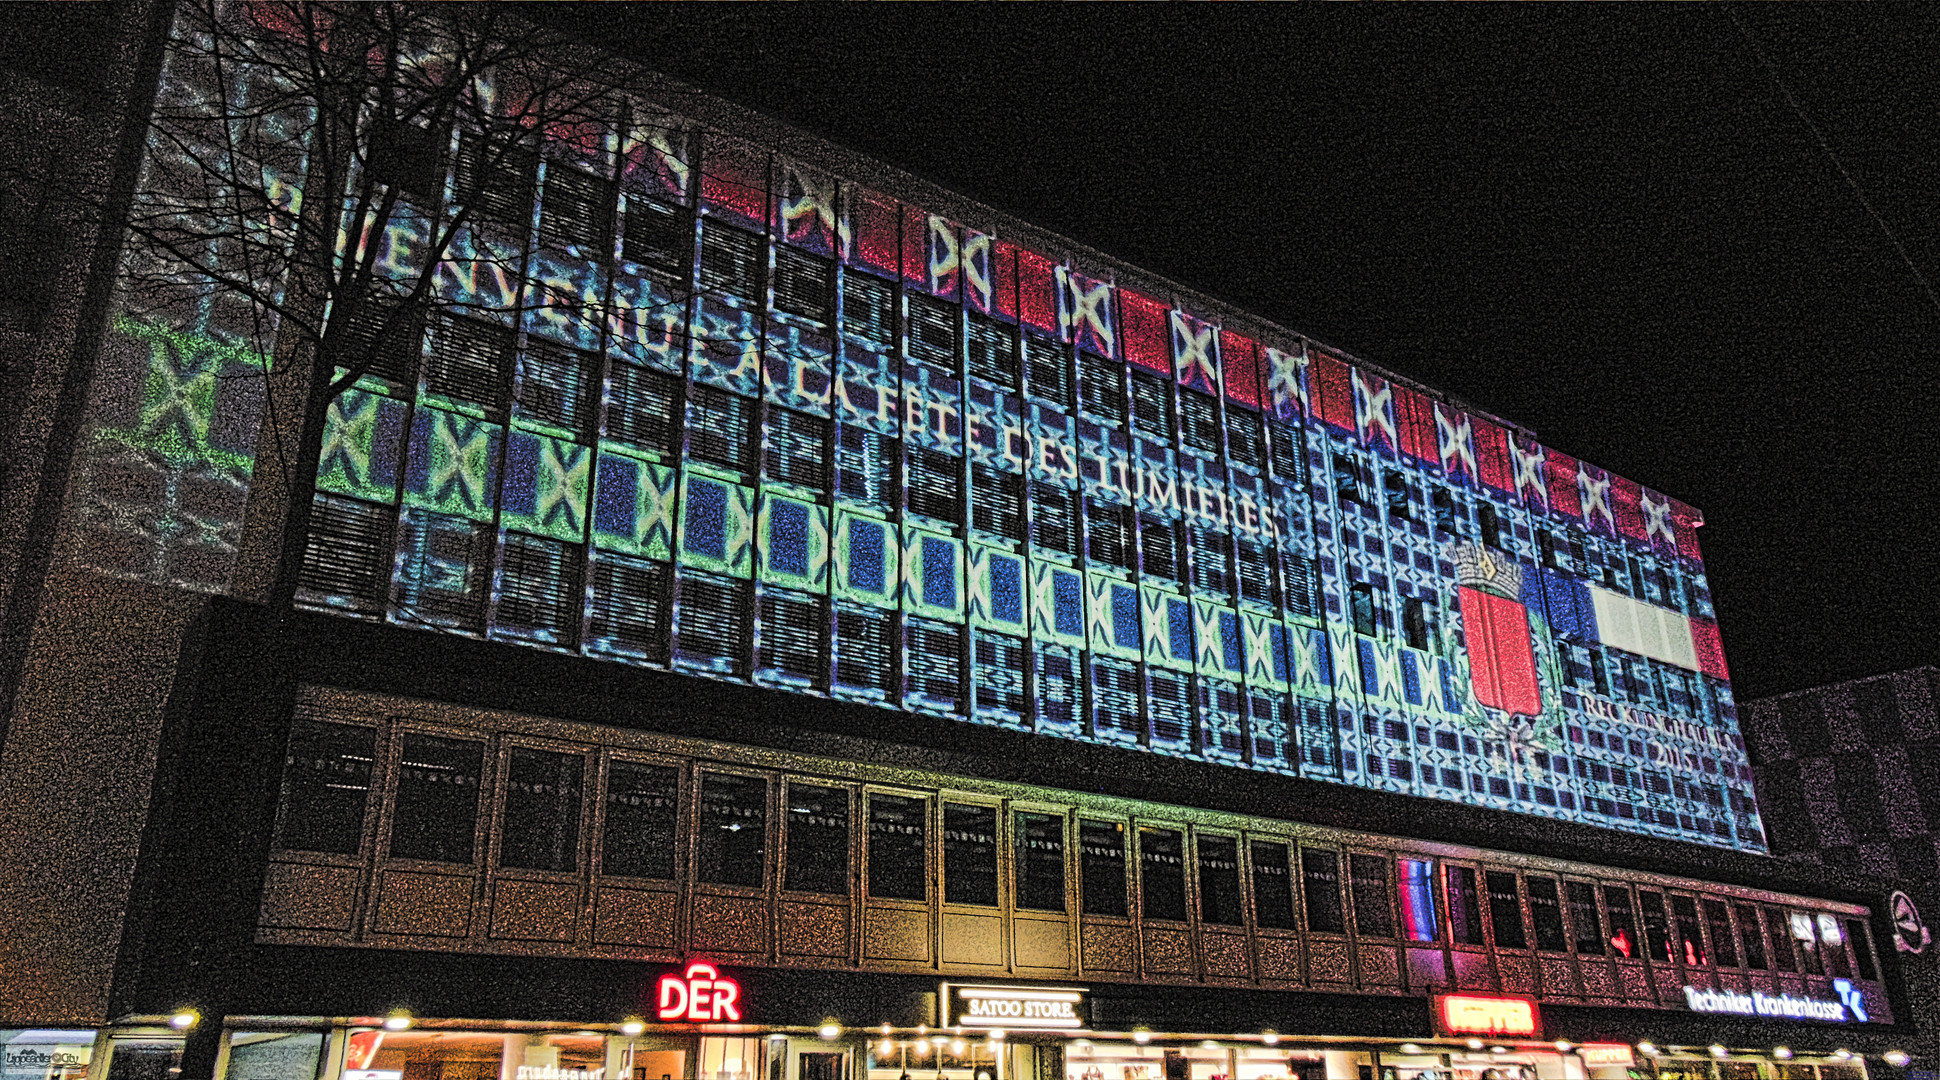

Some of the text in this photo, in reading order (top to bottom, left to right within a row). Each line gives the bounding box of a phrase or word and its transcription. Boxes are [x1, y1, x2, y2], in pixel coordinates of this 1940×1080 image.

[794, 358, 859, 415] LA
[876, 382, 983, 451] FÊTE
[1002, 420, 1080, 480] DES
[1098, 454, 1280, 540] LUMIÈRES
[659, 977, 740, 1021] DER
[969, 999, 1022, 1017] SATOO
[1683, 985, 1846, 1021] Techniker Krankenkasse
